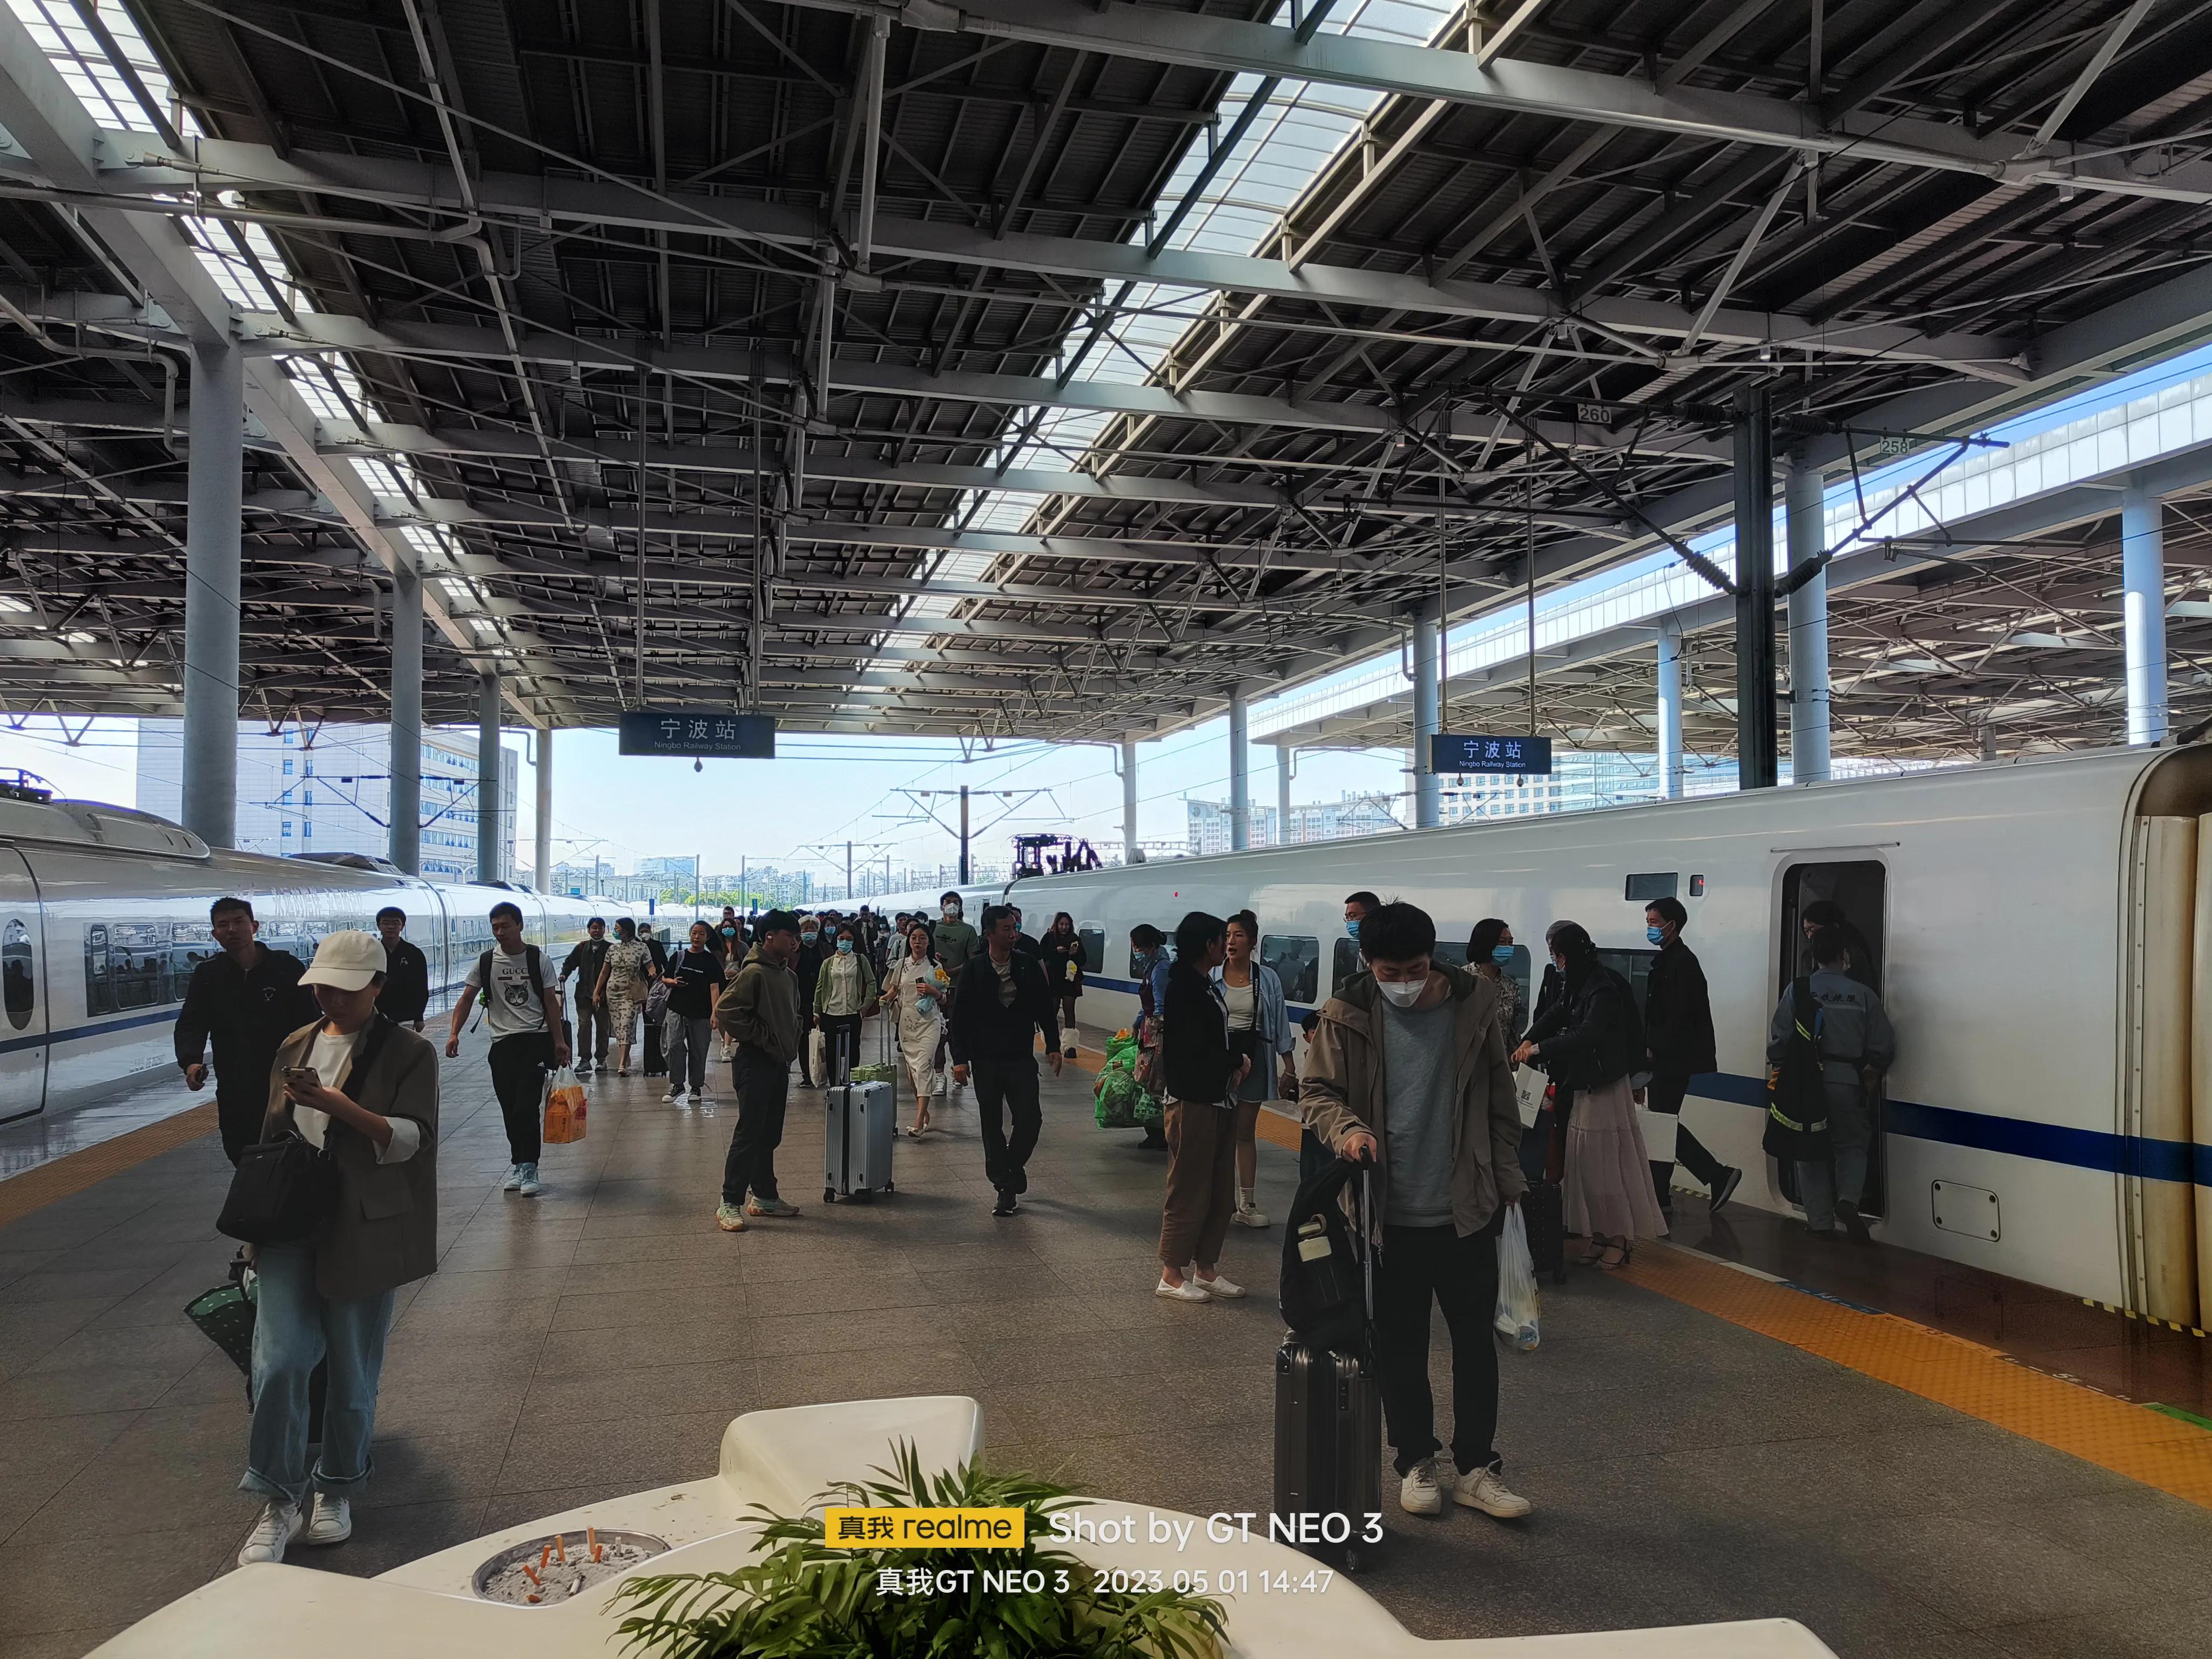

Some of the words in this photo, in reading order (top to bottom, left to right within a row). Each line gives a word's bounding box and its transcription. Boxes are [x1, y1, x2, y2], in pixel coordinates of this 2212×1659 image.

[1580, 408, 1609, 422] 260
[1882, 441, 1908, 454] 258
[660, 718, 736, 740] 宁波站
[655, 741, 681, 750] Ningbo
[684, 742, 713, 751] Railway
[1464, 740, 1522, 759] 宁波站
